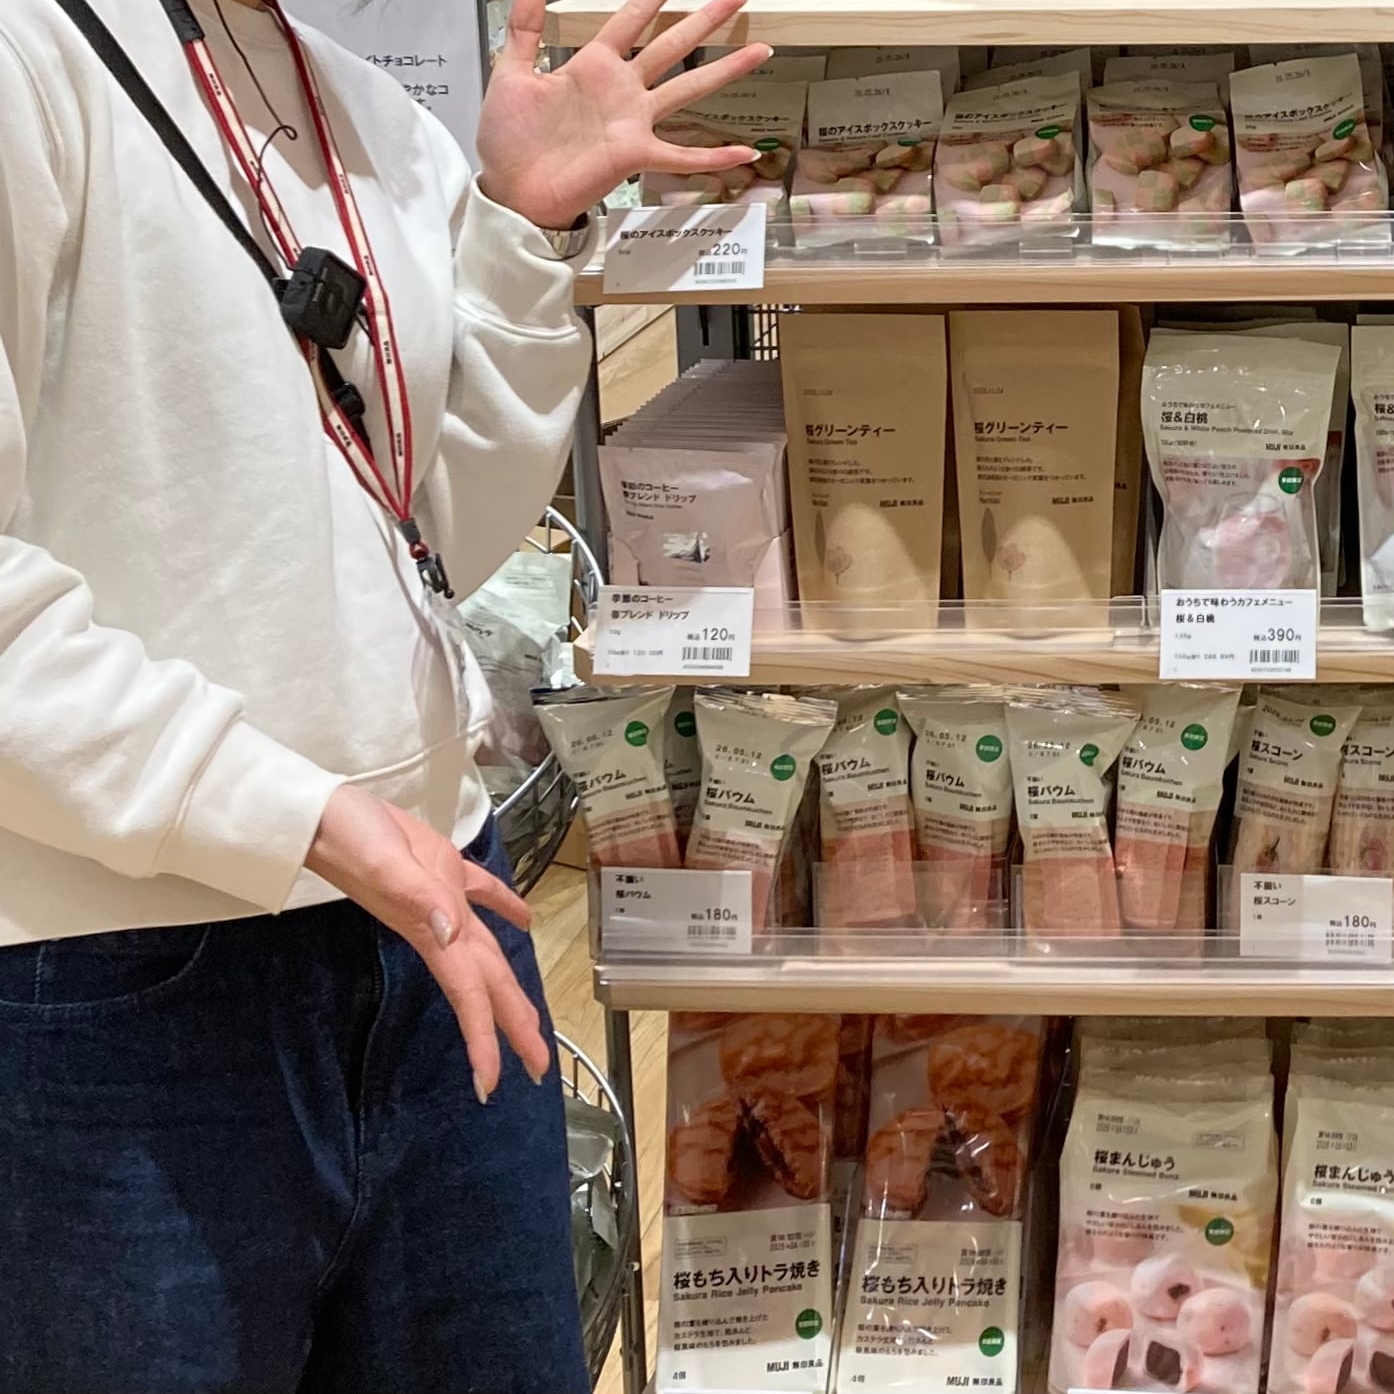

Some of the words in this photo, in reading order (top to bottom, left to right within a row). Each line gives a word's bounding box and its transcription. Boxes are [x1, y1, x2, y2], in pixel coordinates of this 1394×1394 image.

[1161, 411, 1209, 424] 桜&白桃
[806, 425, 896, 437] 桜グリーンティー
[974, 421, 1069, 435] 桜グリーンティー
[665, 493, 697, 504] ドリップ
[1176, 597, 1293, 607] おうちで味わうカフェメニュー
[659, 611, 690, 620] ドリップ
[1251, 740, 1303, 761] 桜スコーン
[821, 757, 871, 776] 桜バウム
[1122, 756, 1166, 775] 桜バウム
[925, 769, 965, 788] 桜バウム
[706, 788, 755, 805] 桜バウム
[1027, 784, 1076, 797] 桜バウム
[616, 890, 651, 899] 桜バウム
[1253, 896, 1296, 906] 桜スコーン
[1094, 1149, 1175, 1170] 桜まんじゅう
[1314, 1164, 1394, 1184] 桜まんじゅう
[673, 1260, 820, 1290] 桜もち入りトラ焼き
[861, 1275, 1007, 1296] 桜もち入りトラ焼き
[673, 1291, 708, 1302] Sakura
[711, 1289, 733, 1299] Rice
[762, 1283, 803, 1295] Pancake
[860, 1296, 894, 1306] Sakura
[897, 1297, 919, 1306] Rice
[921, 1297, 945, 1308] Jelly
[767, 1361, 790, 1373] MUJI
[946, 1376, 969, 1386] MUJI
